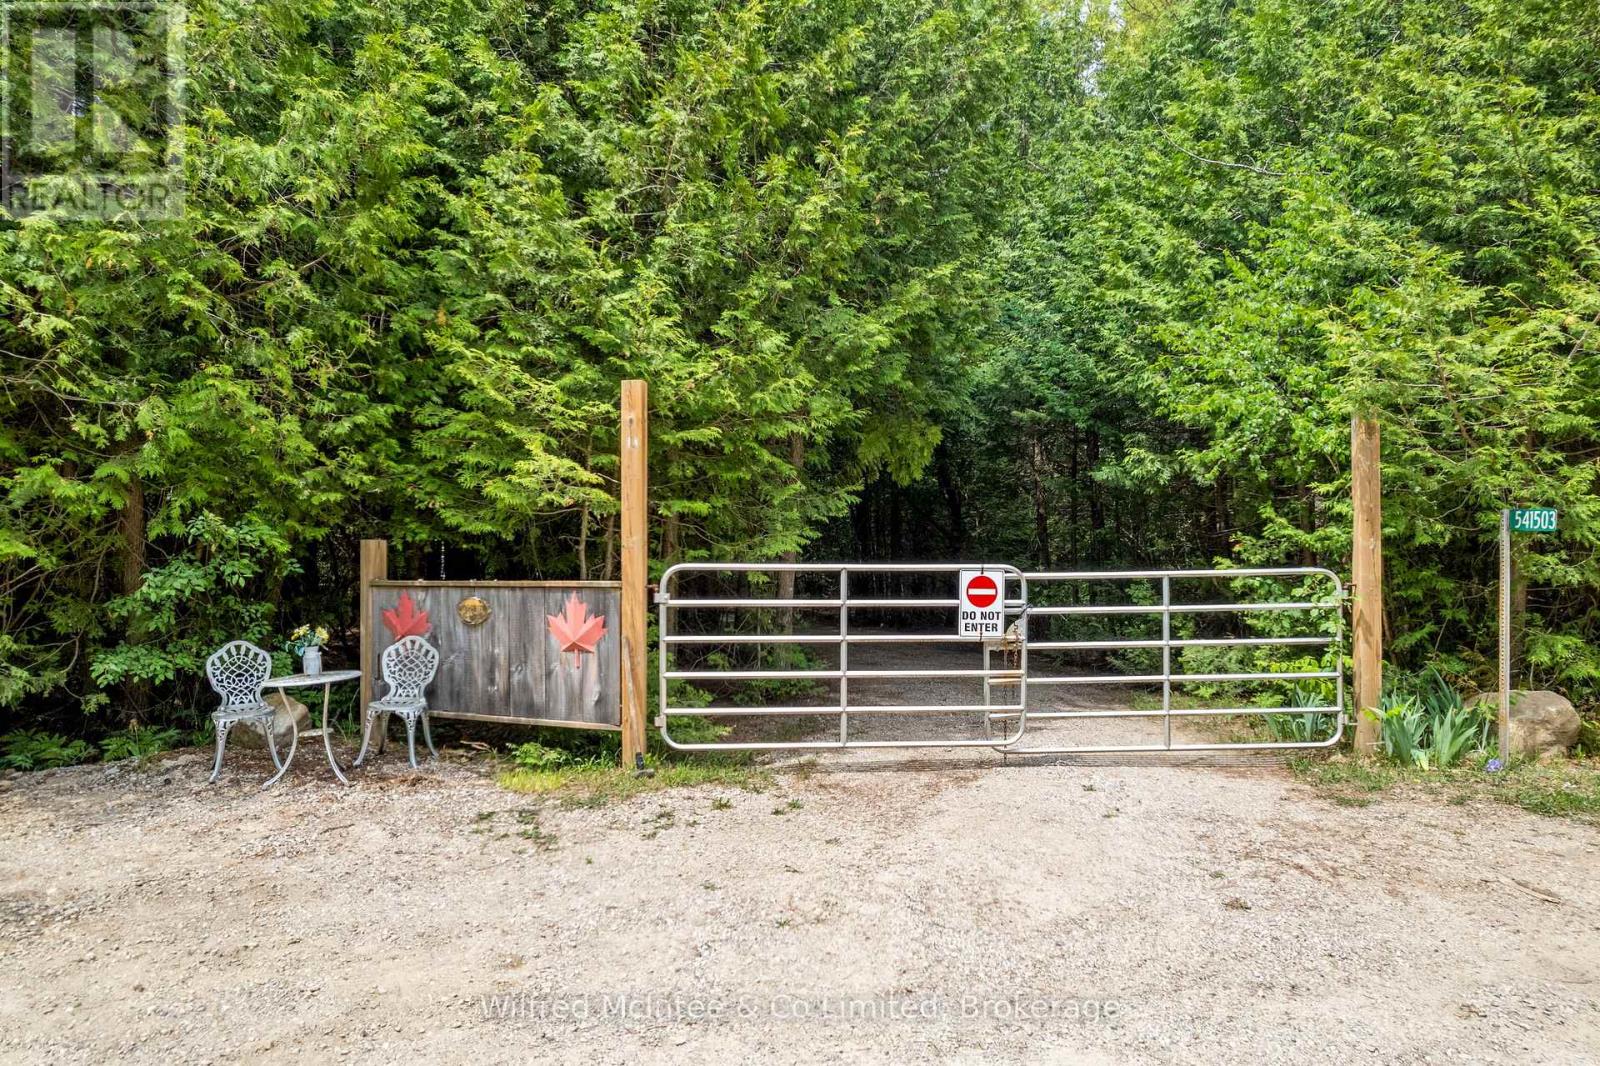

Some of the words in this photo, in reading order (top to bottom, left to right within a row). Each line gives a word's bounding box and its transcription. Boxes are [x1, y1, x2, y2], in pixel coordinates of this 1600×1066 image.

[1514, 510, 1556, 529] 541503
[962, 611, 976, 620] DO
[980, 611, 1001, 620] NOT
[964, 622, 998, 632] ENTER
